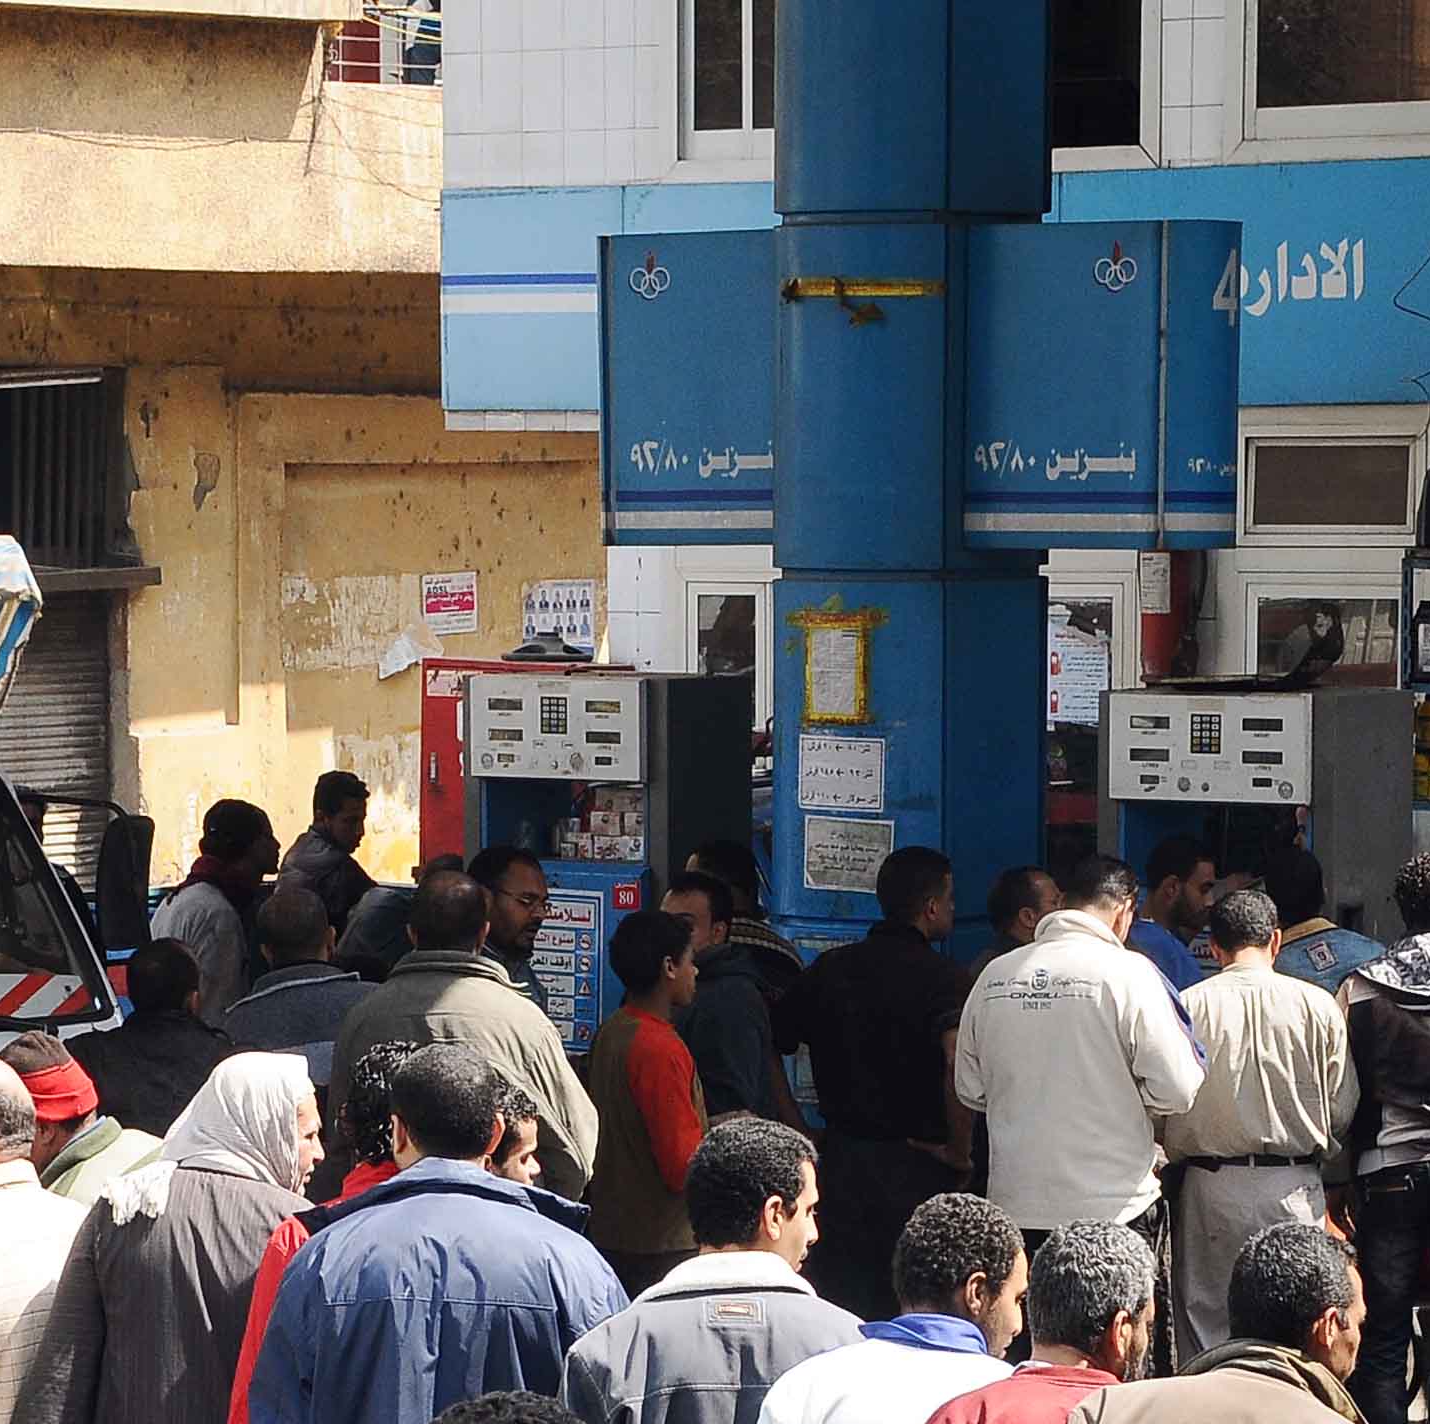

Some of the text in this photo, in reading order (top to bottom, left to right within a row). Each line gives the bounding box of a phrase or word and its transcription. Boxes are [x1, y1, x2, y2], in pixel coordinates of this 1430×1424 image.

[1212, 248, 1238, 328] 4
[699, 440, 774, 479] نزين
[1045, 440, 1137, 481] بنزين
[619, 890, 635, 905] 80
